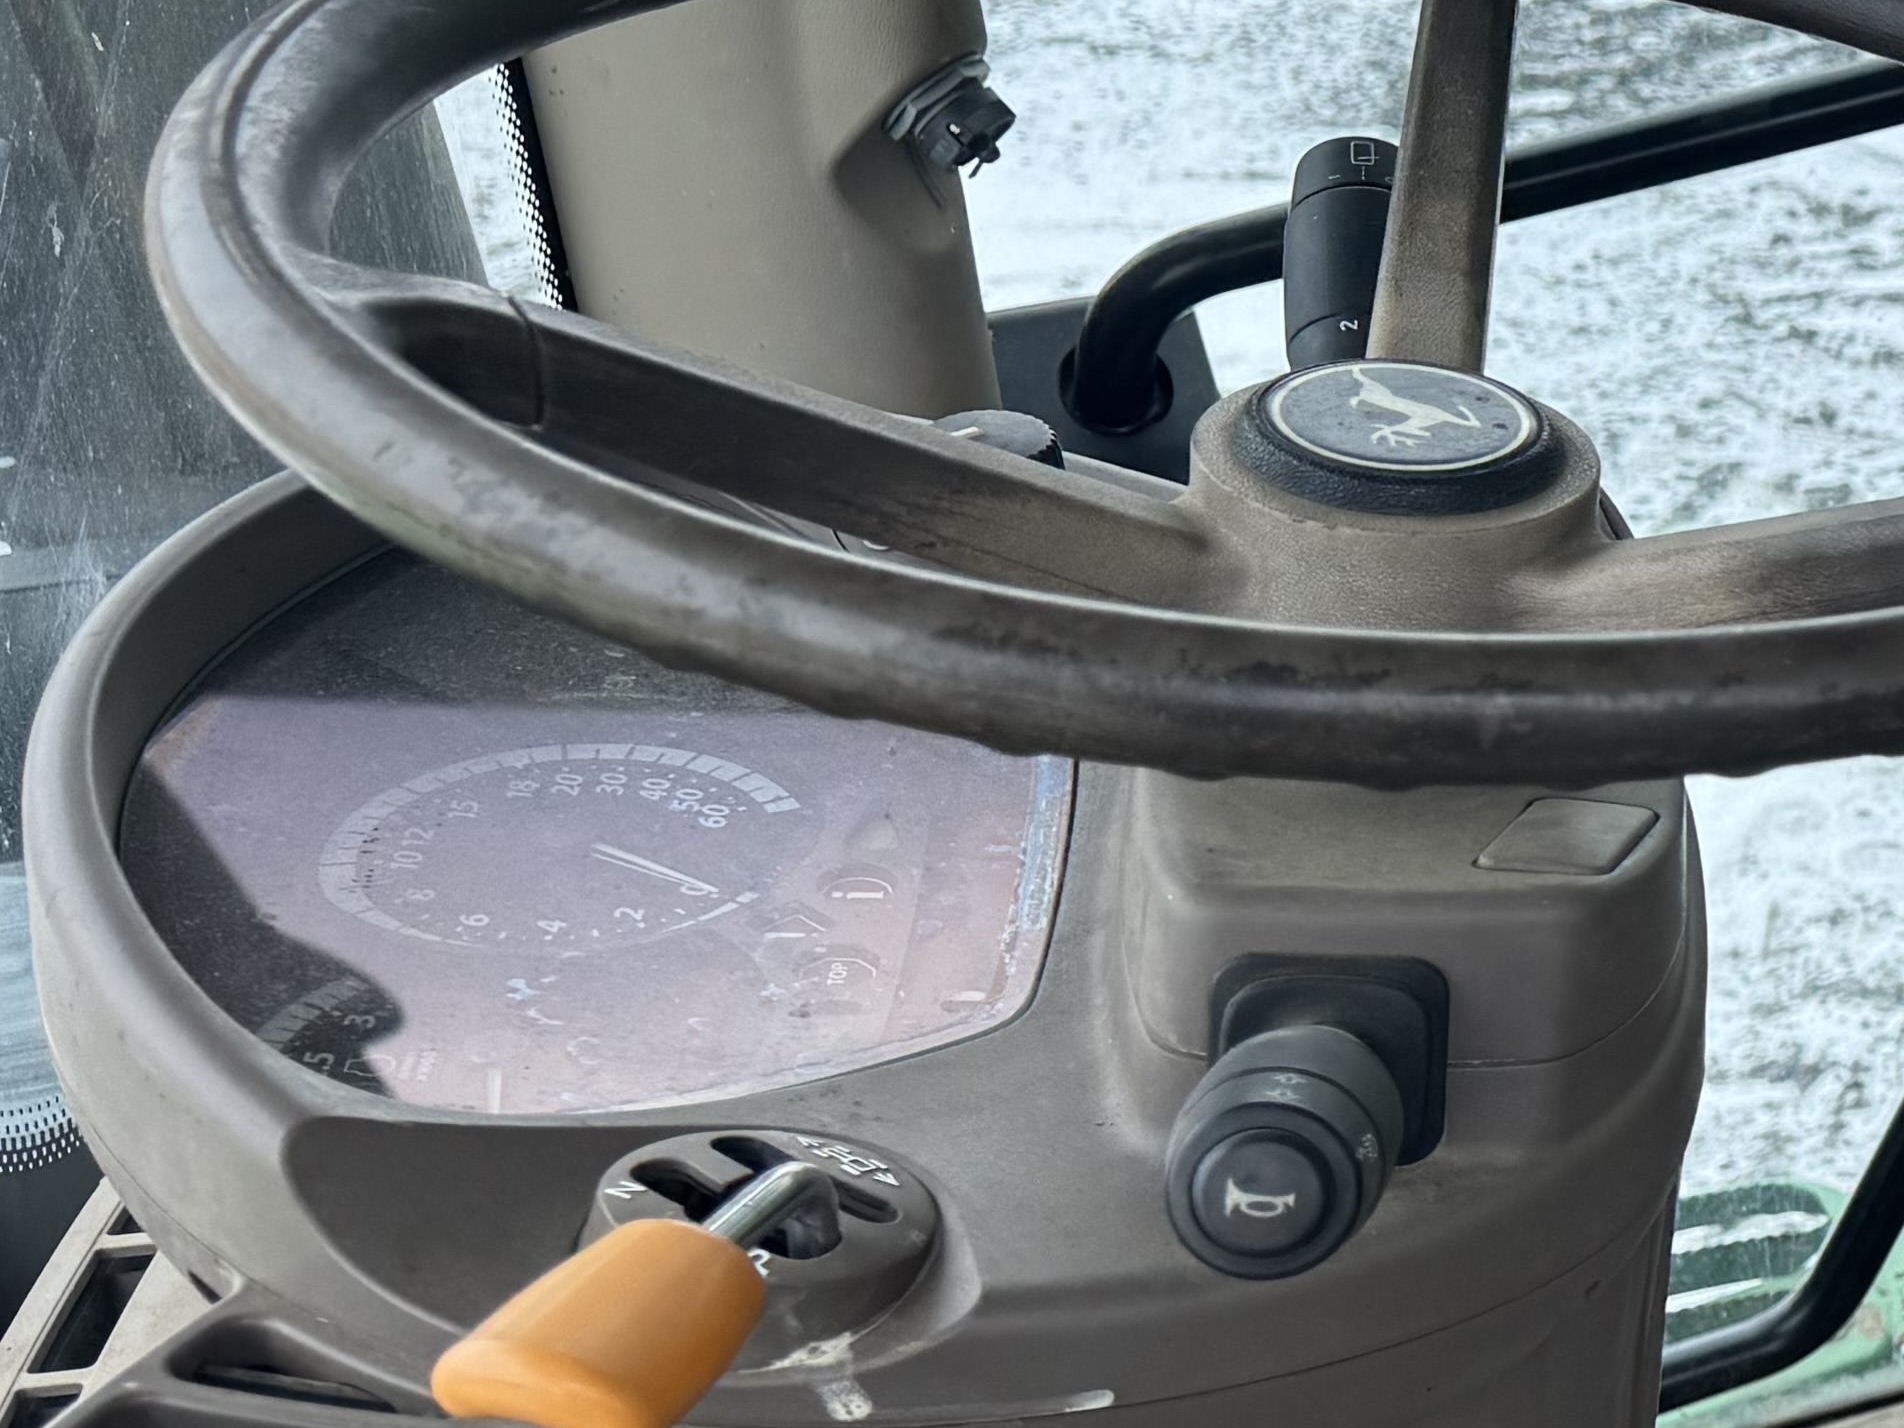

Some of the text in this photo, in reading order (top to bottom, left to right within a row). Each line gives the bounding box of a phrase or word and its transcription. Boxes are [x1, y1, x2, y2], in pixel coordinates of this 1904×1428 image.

[1339, 319, 1358, 331] 2
[550, 773, 583, 796] 20
[595, 773, 628, 796] 30
[639, 778, 671, 801] 40
[447, 800, 478, 818] 15
[668, 788, 704, 812] 50
[698, 804, 730, 828] 60
[390, 851, 422, 869] 10
[614, 907, 645, 921] 2
[343, 1014, 376, 1029] 3
[604, 1180, 647, 1199] N
